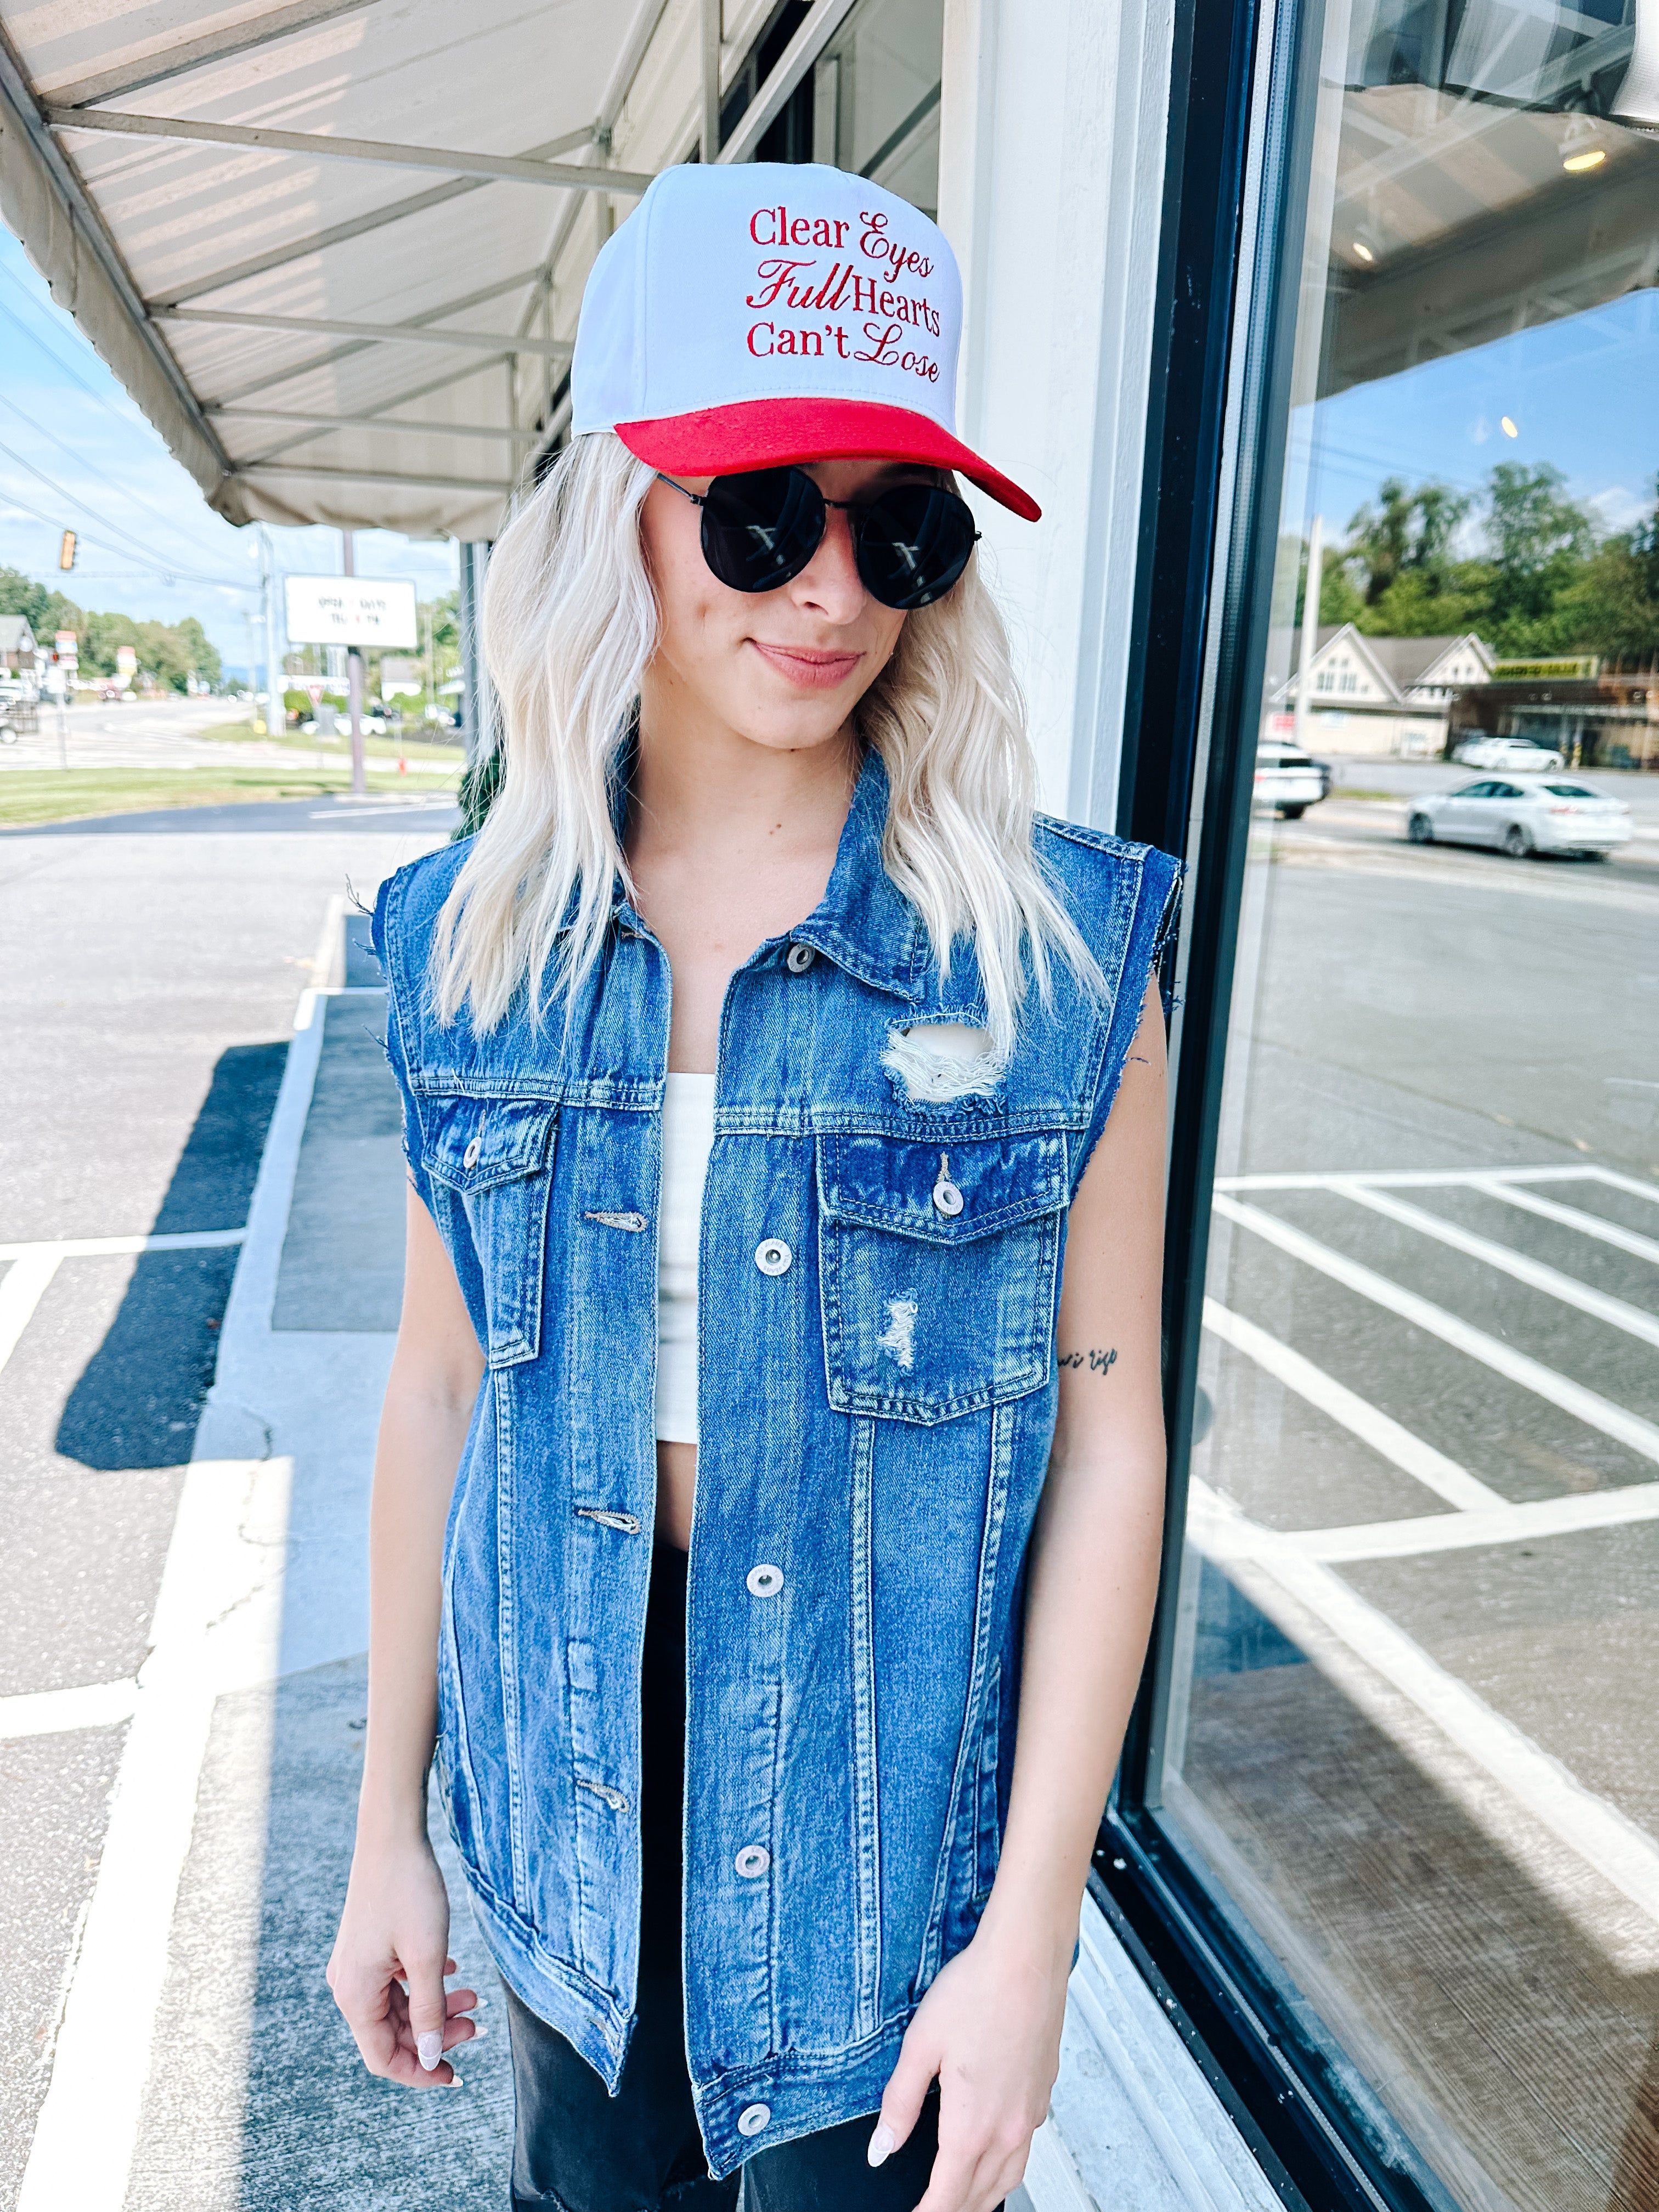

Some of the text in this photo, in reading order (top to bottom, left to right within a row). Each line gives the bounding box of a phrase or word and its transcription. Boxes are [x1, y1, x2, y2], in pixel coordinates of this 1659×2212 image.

[749, 206, 934, 283] Clear Eyes
[746, 259, 940, 337] Full Hearts
[747, 321, 940, 383] Can't Lose
